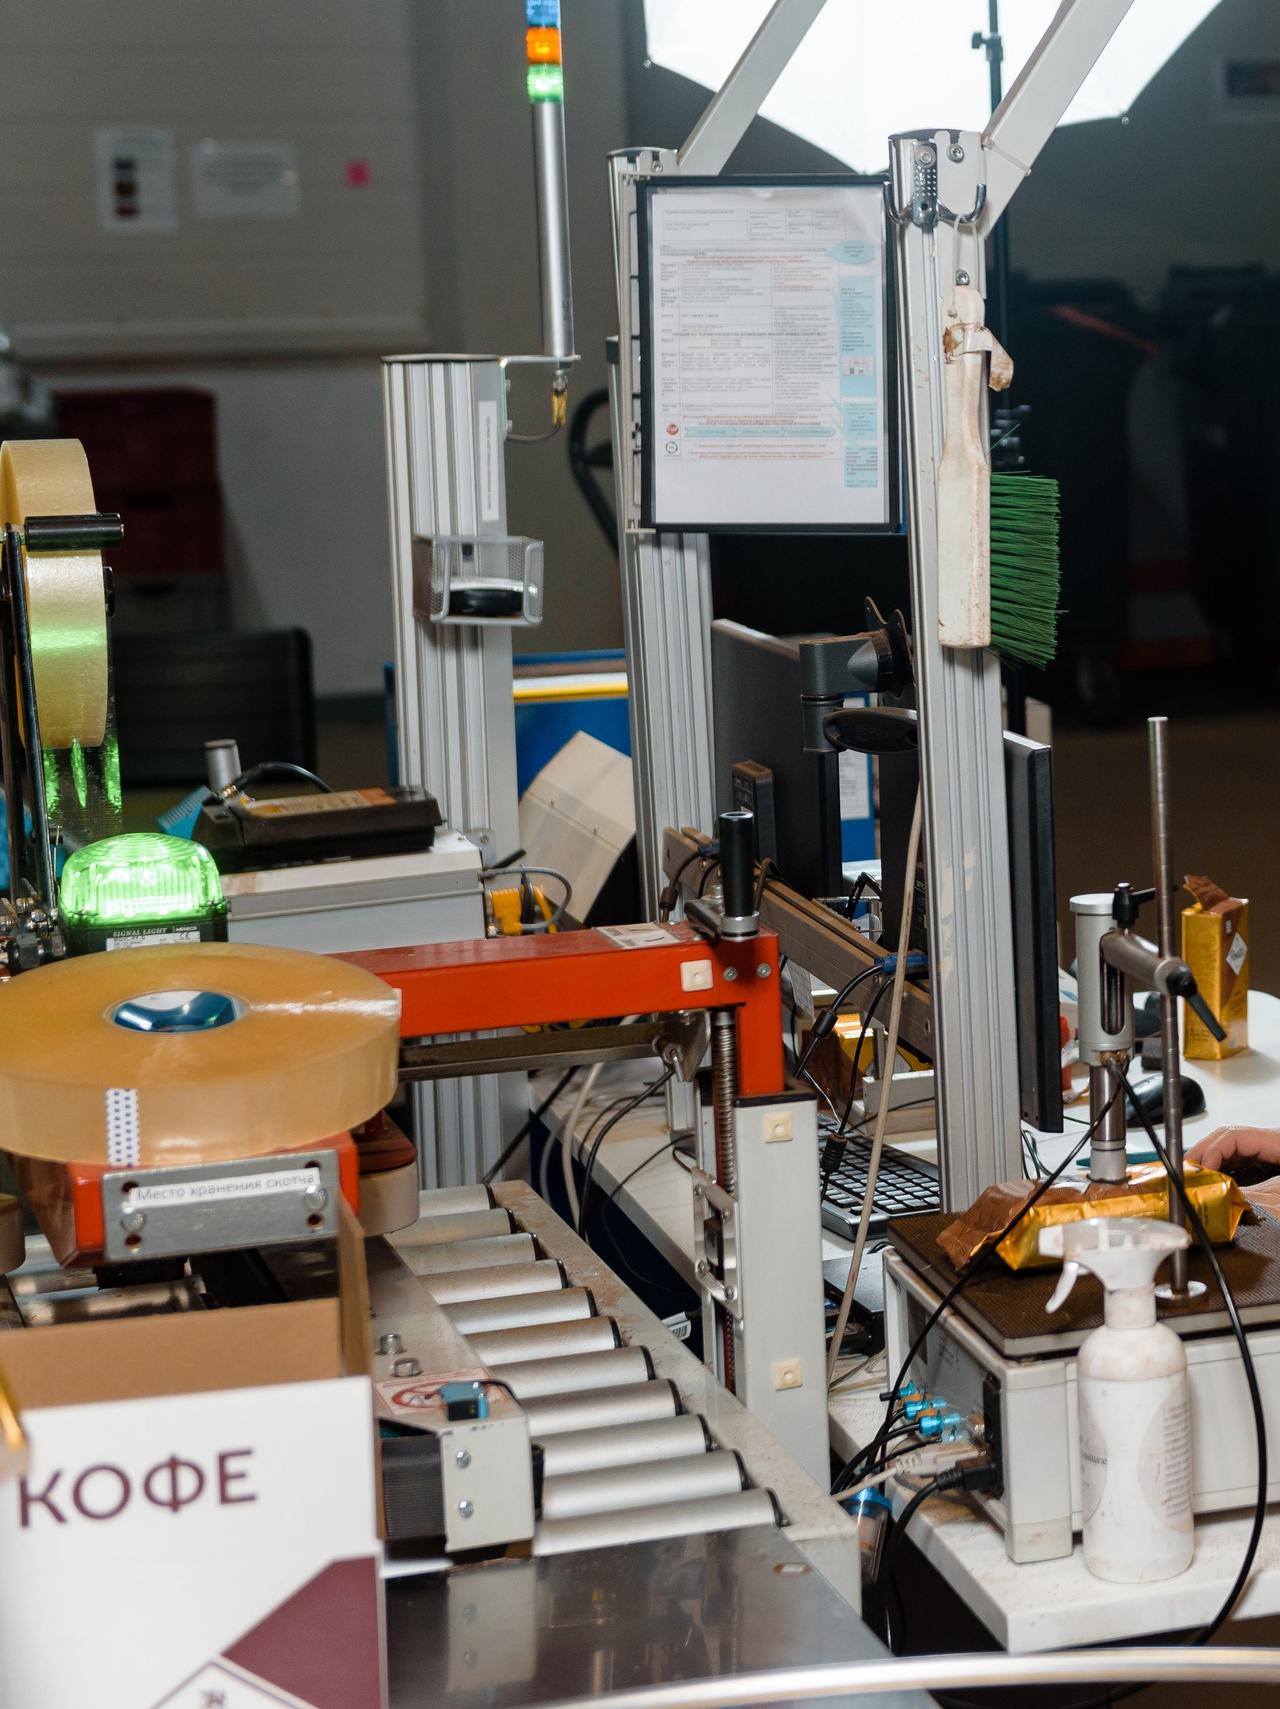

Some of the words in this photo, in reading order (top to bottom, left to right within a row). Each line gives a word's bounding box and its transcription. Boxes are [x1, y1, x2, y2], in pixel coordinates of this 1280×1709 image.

[113, 929, 141, 937] SIGNAL
[143, 927, 167, 935] LIGHT
[137, 1184, 186, 1203] Место
[190, 1178, 263, 1200] хранения
[266, 1171, 316, 1189] скотча
[18, 1447, 259, 1528] КОФЕ
